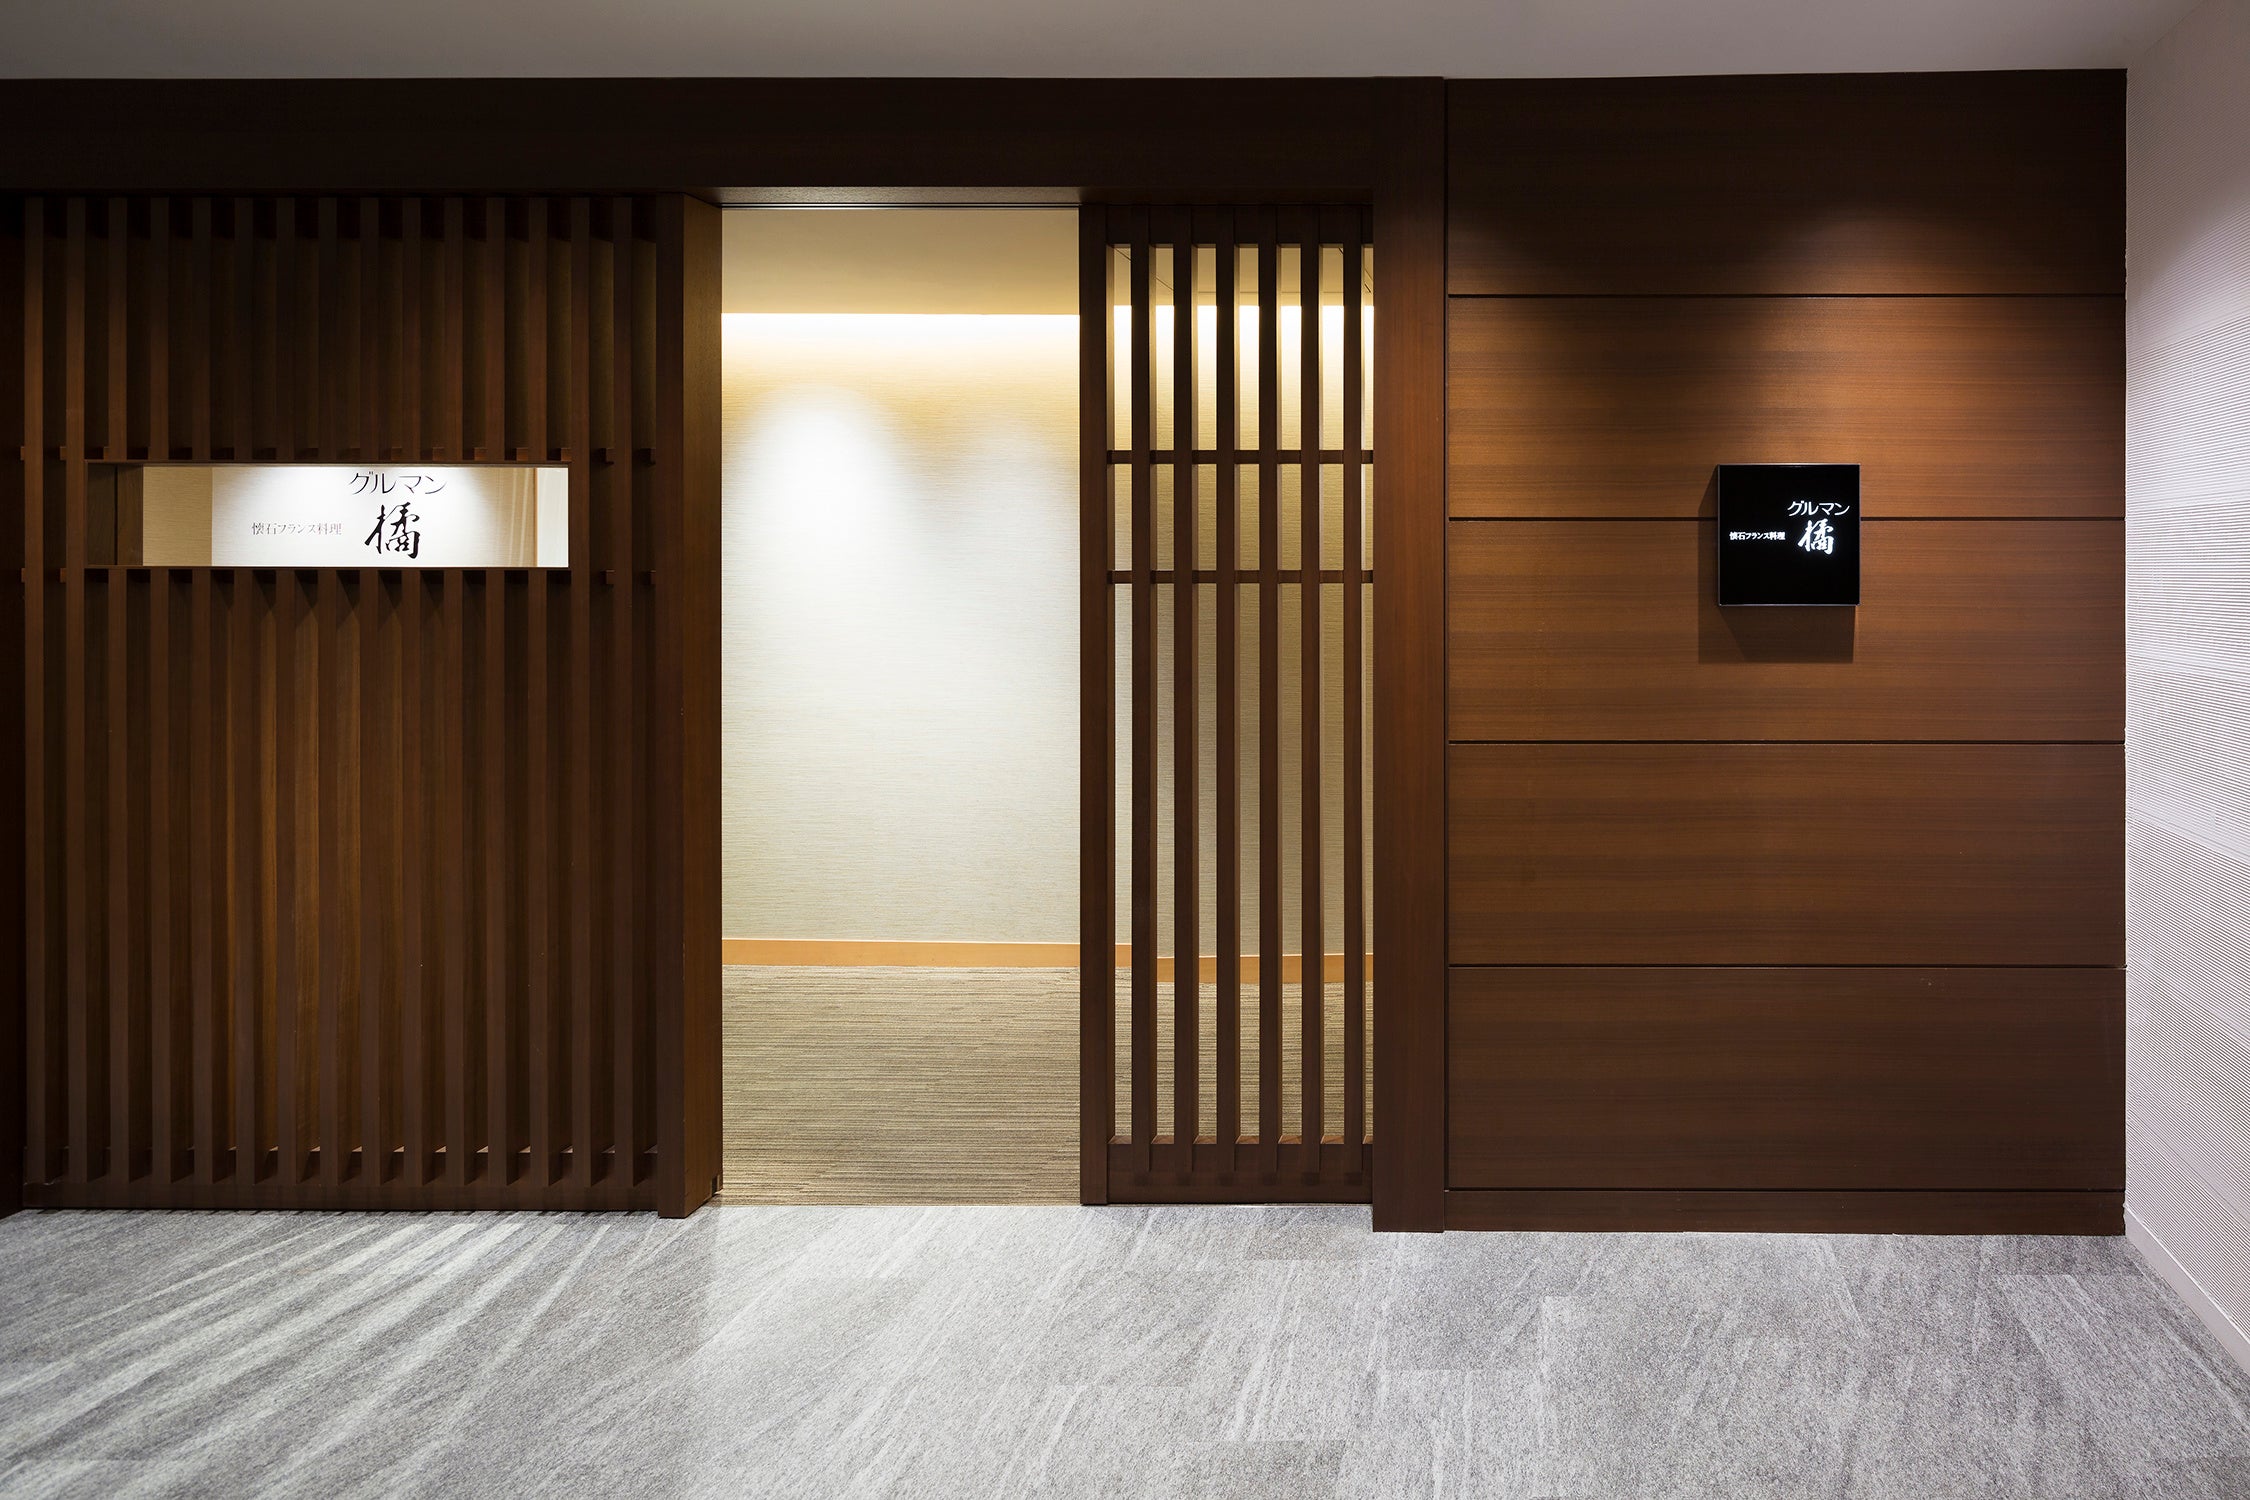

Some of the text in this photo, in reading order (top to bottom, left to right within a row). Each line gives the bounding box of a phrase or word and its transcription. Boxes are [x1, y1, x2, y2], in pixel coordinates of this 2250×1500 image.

[350, 471, 446, 495] グルマン
[1787, 500, 1850, 517] グルマン
[251, 522, 342, 536] 懐石フランス料理
